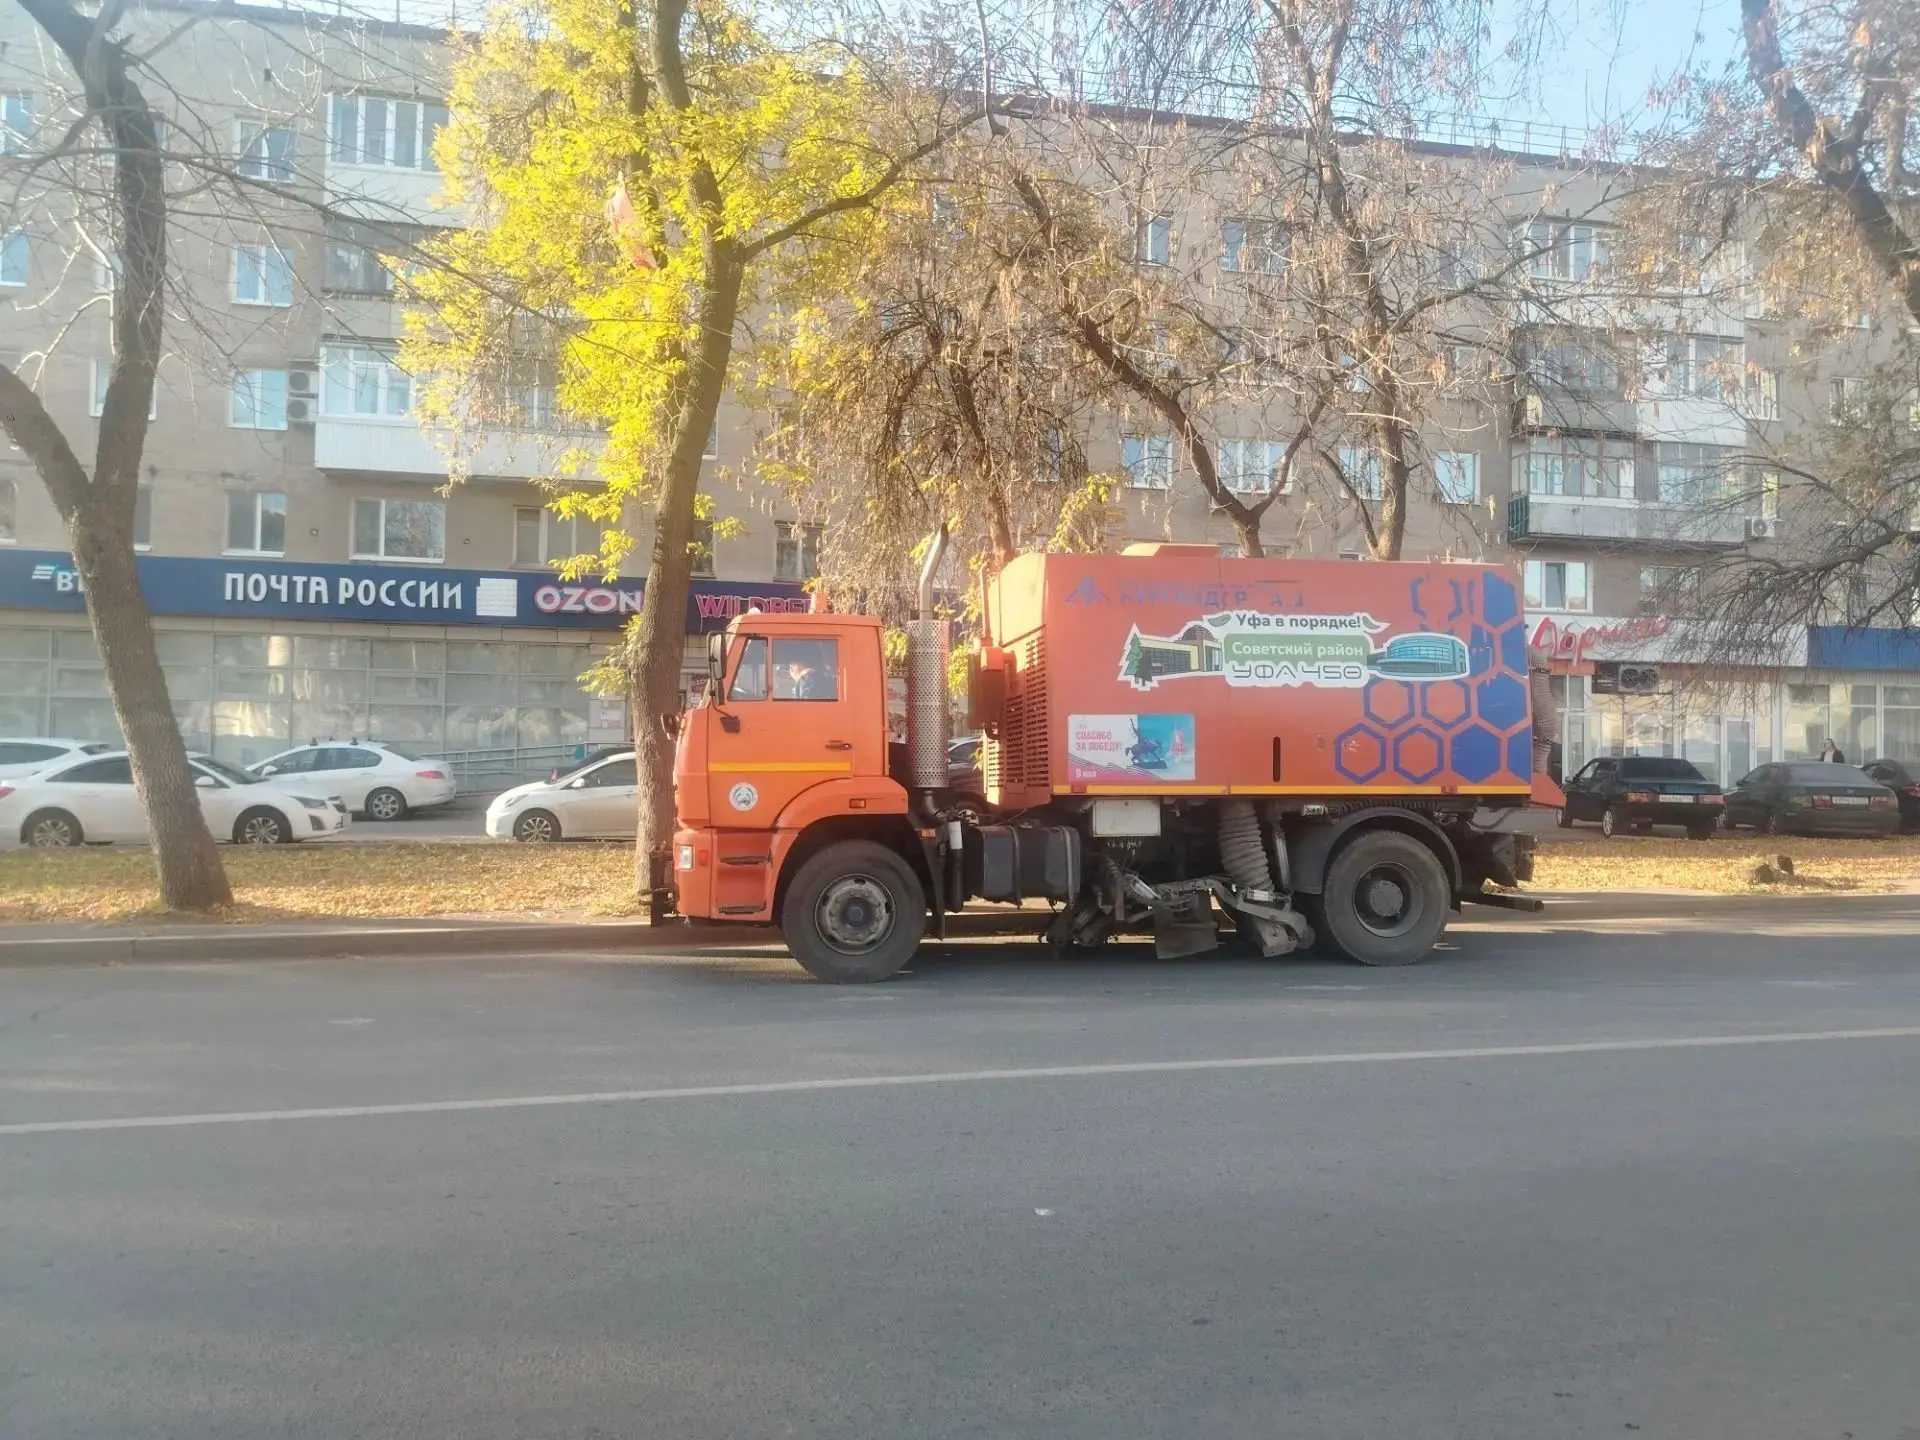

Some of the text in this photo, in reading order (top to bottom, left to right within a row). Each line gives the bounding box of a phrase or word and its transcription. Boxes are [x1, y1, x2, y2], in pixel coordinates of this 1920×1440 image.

[224, 572, 462, 610] ПОЧТА РОССИИ
[534, 586, 643, 614] OZON
[1236, 613, 1361, 630] Уфа в порядке!
[1232, 642, 1363, 658] Советский район
[1076, 731, 1112, 740] СПАСИБО
[1076, 742, 1087, 751] ЗА
[1075, 768, 1082, 778] 9
